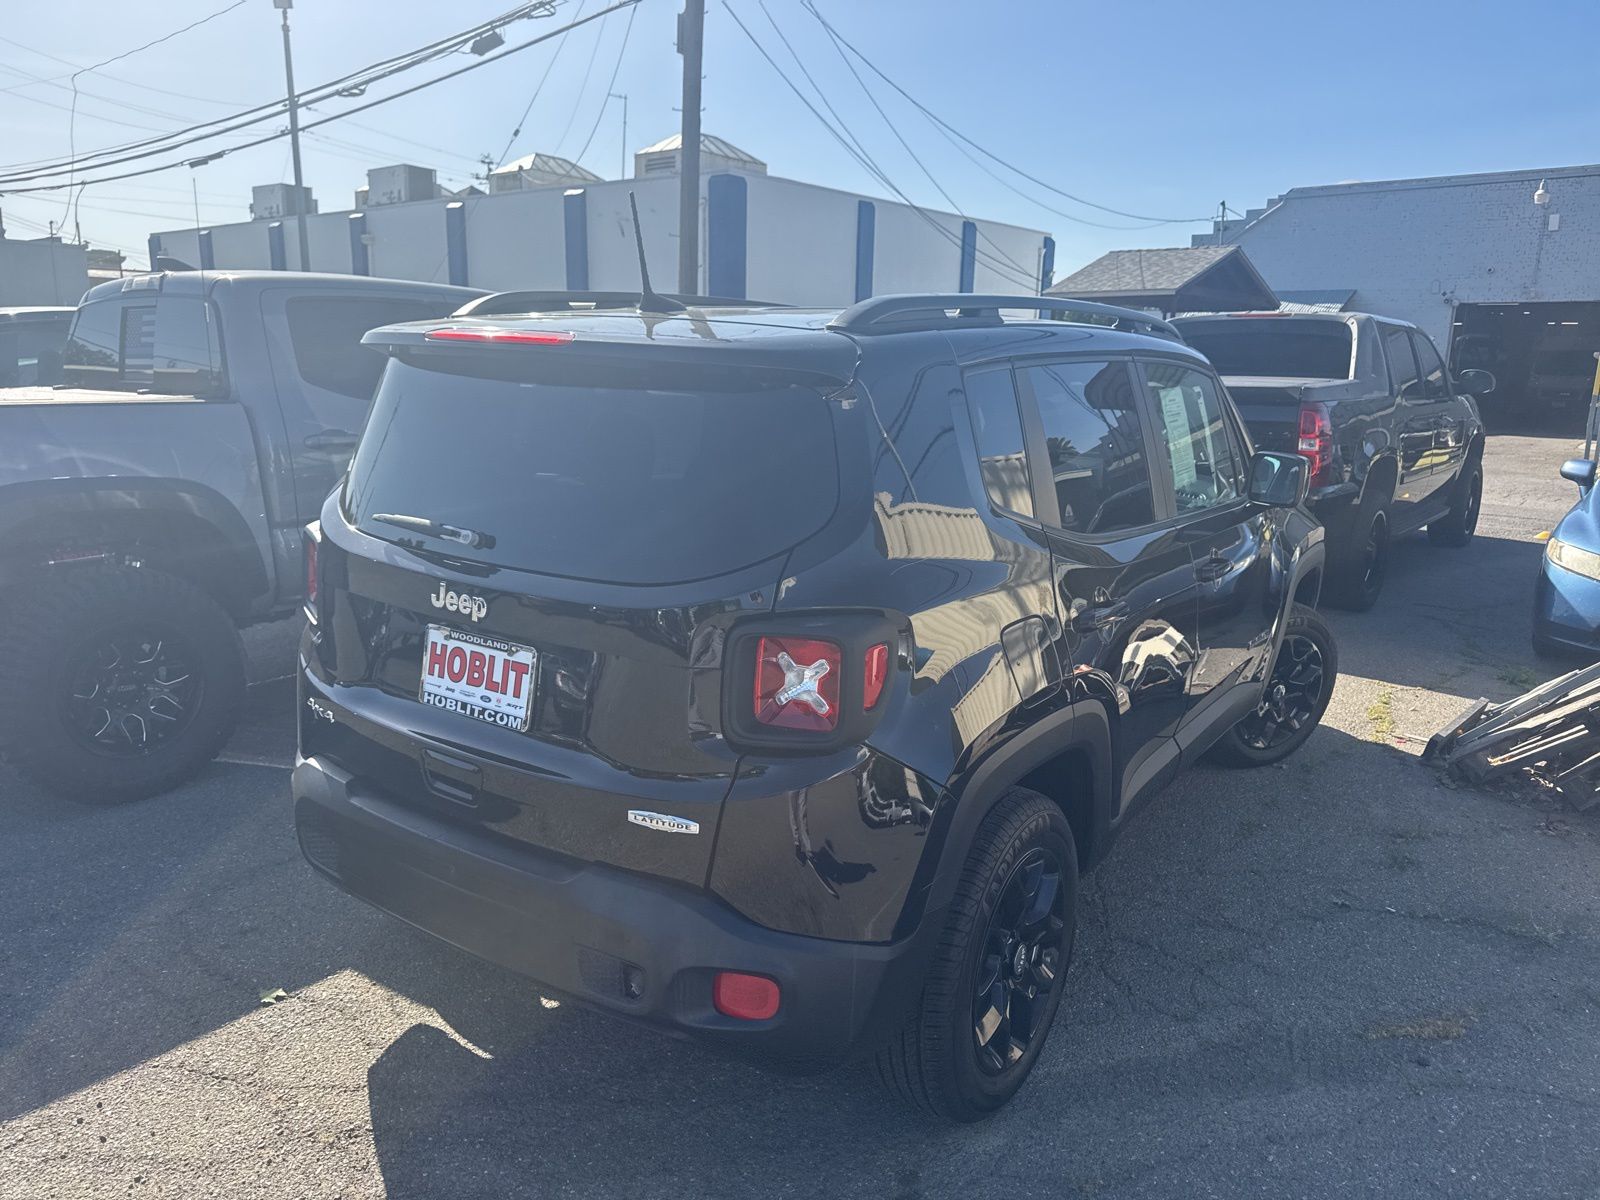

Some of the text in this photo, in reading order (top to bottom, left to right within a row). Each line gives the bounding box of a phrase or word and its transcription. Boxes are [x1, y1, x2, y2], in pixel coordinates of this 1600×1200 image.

[430, 581, 487, 622] Jeep
[450, 631, 508, 651] WOODLAND
[428, 641, 529, 699] HOBLIT
[424, 692, 522, 730] HOBLIT.COM
[633, 815, 692, 831] LATITUDE
